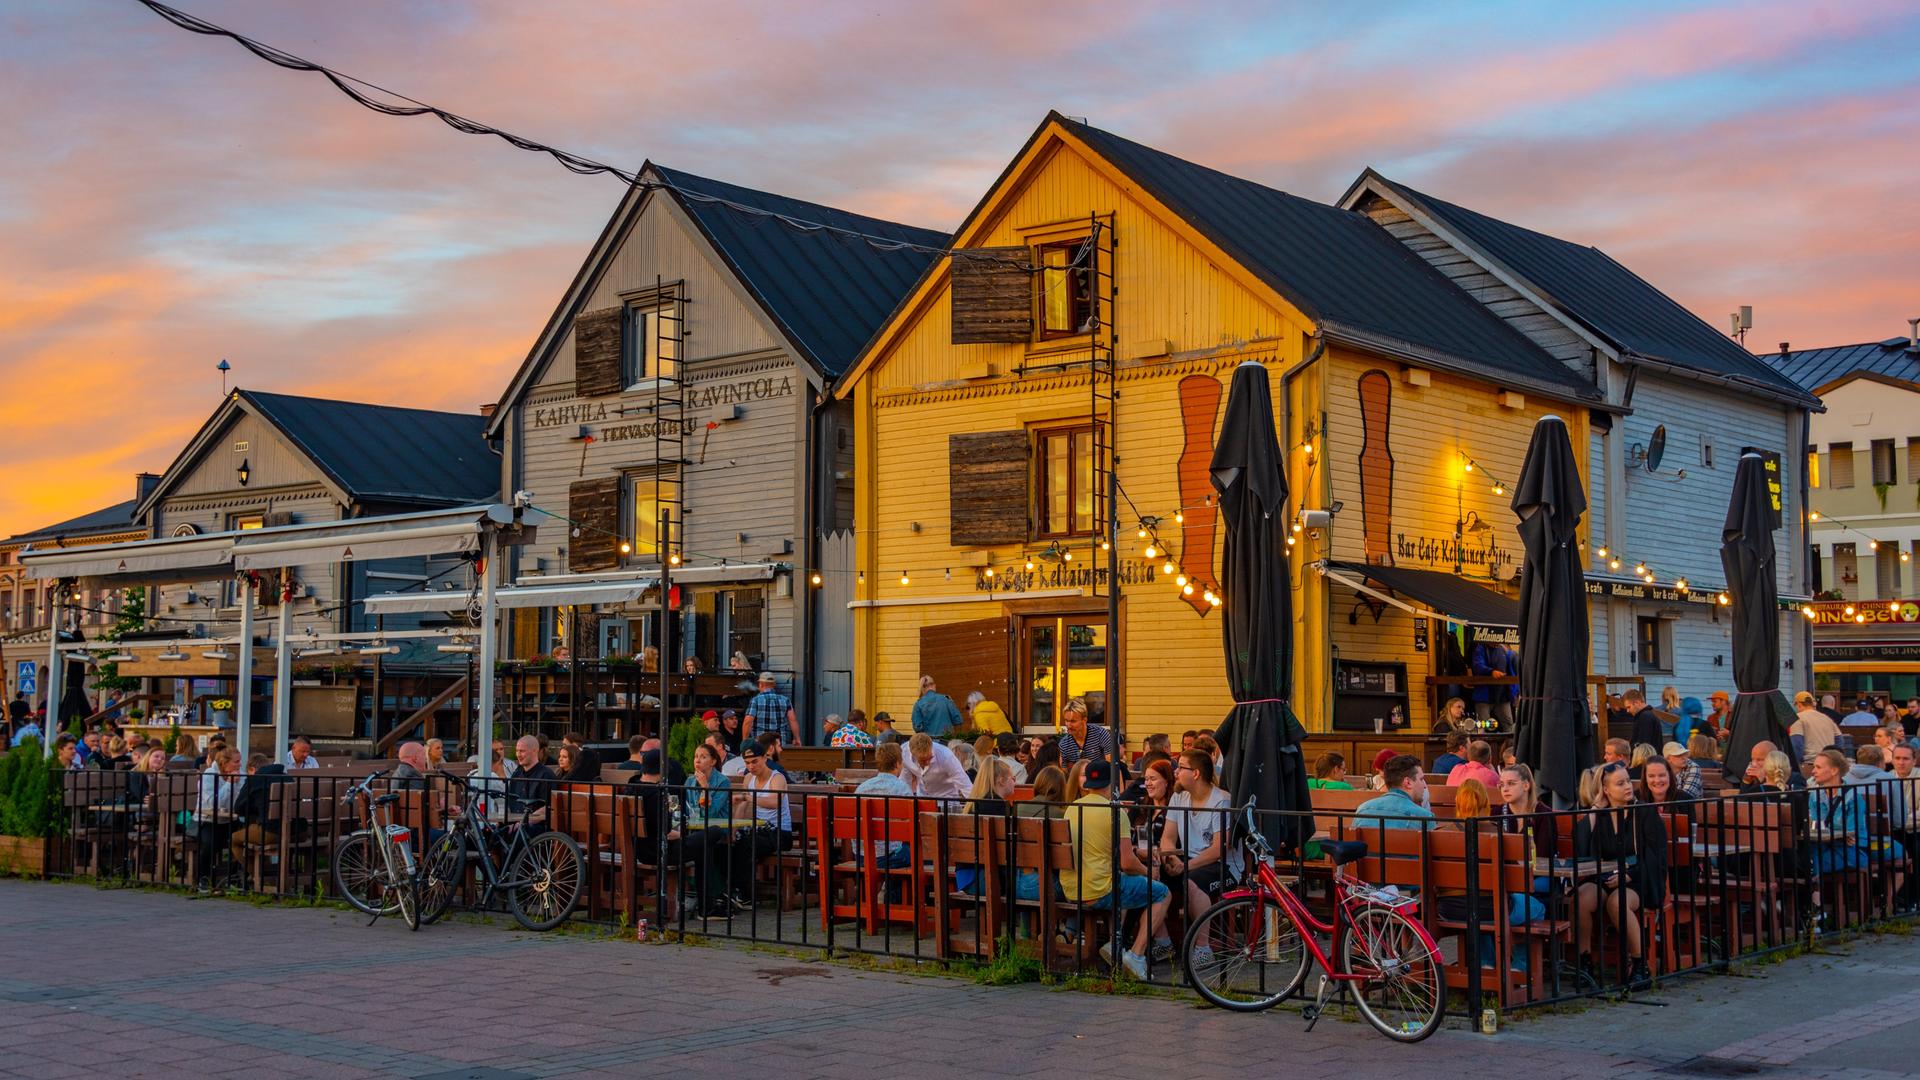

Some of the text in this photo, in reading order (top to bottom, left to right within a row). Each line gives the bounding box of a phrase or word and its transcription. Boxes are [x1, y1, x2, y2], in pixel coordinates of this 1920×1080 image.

[534, 375, 793, 428] KAHVILA RAVINTOLA
[1397, 532, 1416, 559] Bar
[1418, 536, 1439, 567] Cafe
[1861, 647, 1874, 656] TO
